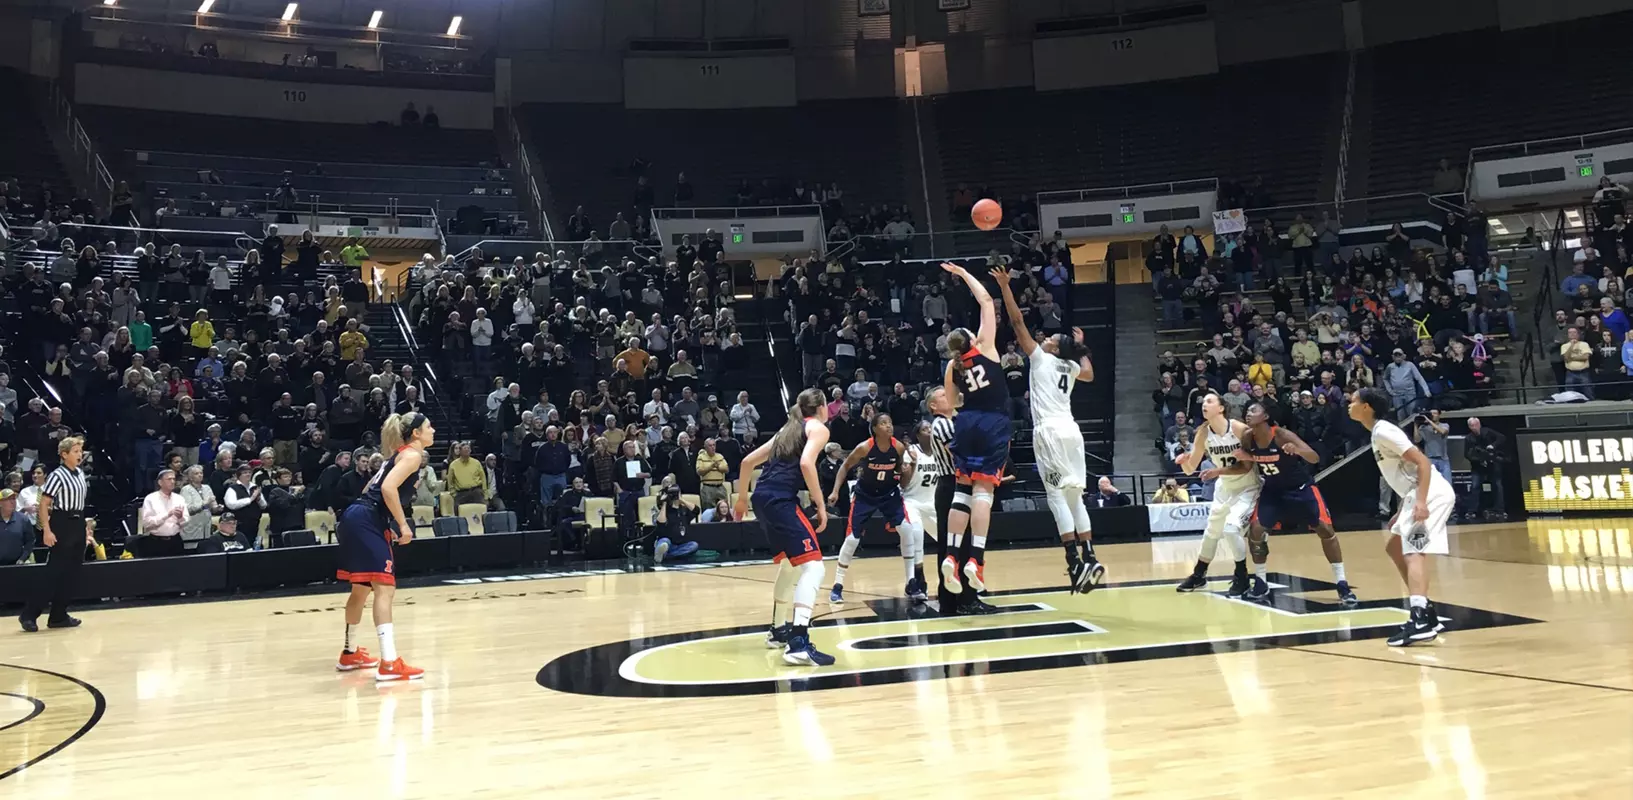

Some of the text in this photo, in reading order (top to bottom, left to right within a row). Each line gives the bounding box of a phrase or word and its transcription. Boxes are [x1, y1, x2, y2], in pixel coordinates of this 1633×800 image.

[1111, 38, 1133, 51] 112
[700, 65, 720, 76] 111
[283, 90, 307, 102] 110
[964, 363, 991, 393] 32
[1057, 373, 1069, 395] 4
[917, 463, 938, 474] PURD
[1259, 462, 1281, 476] 25
[876, 470, 887, 481] 0
[920, 473, 939, 488] 24
[1179, 505, 1211, 518] unit
